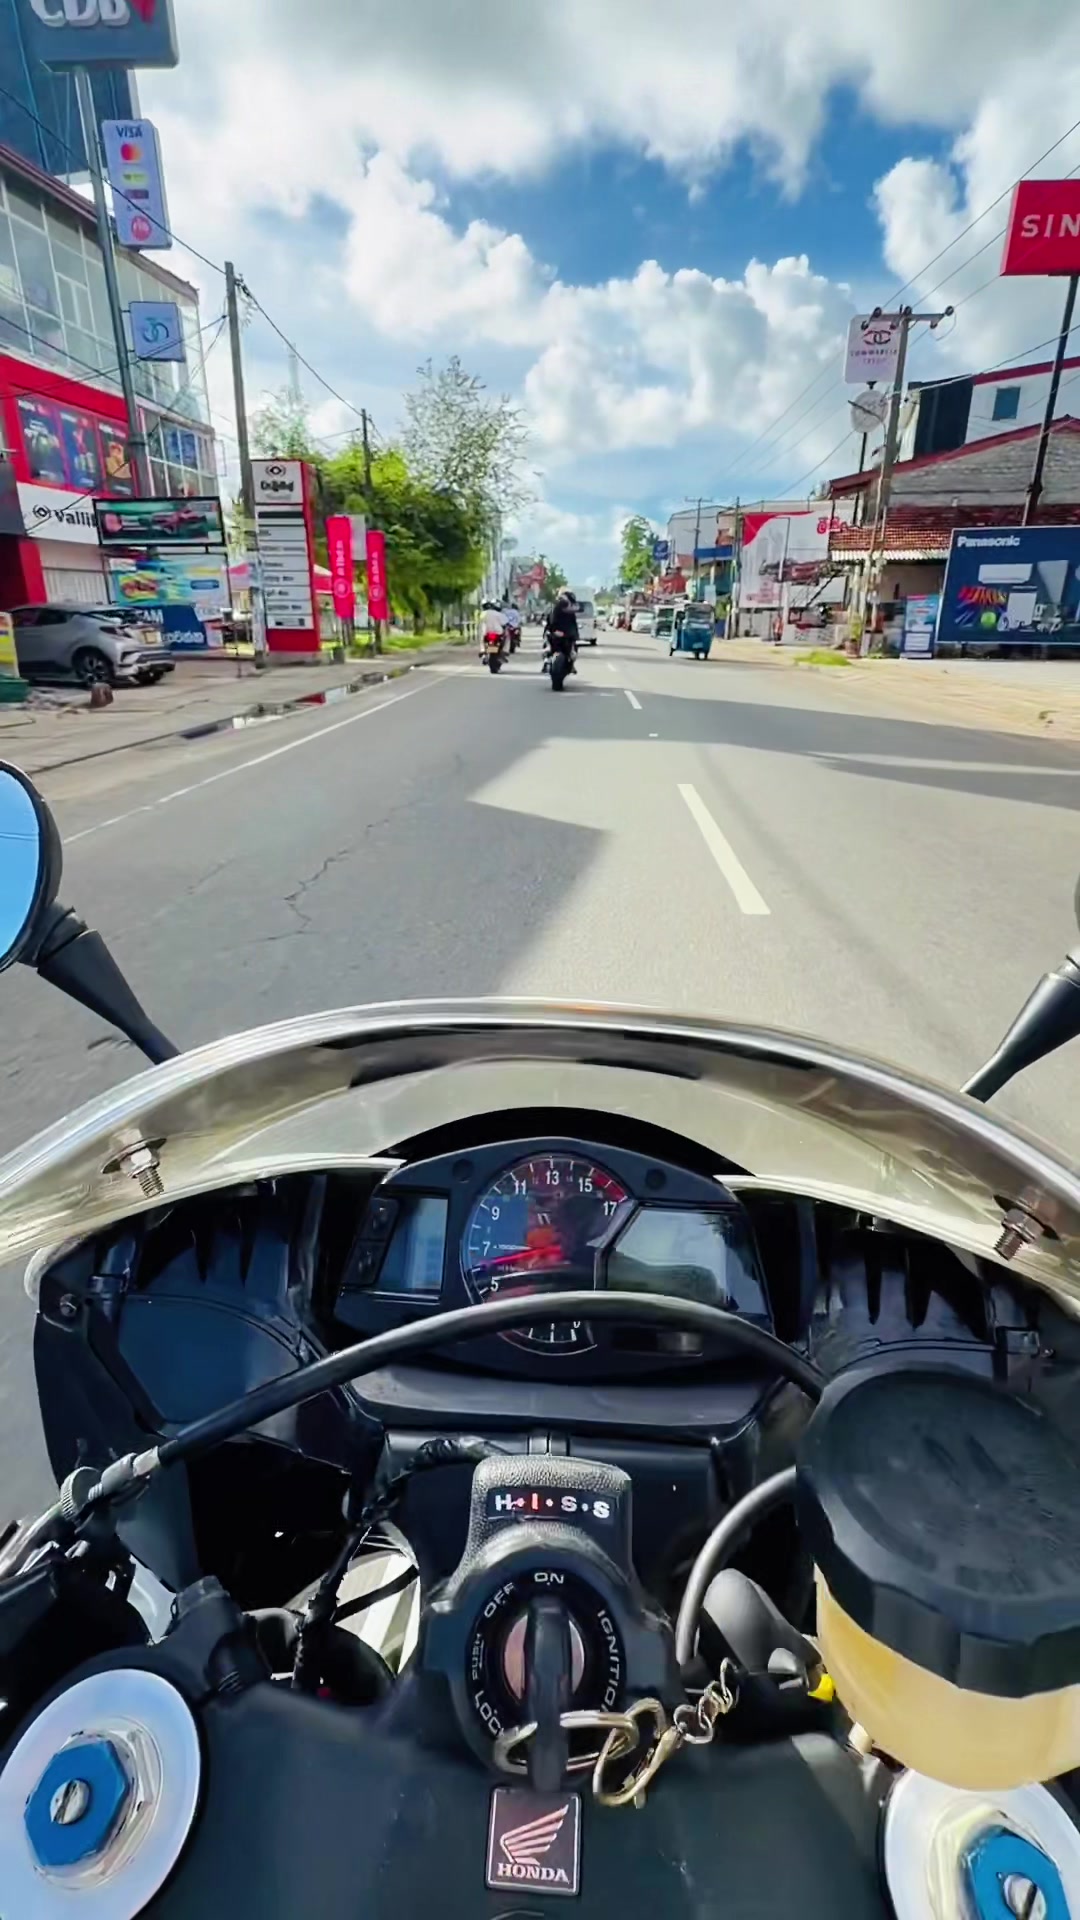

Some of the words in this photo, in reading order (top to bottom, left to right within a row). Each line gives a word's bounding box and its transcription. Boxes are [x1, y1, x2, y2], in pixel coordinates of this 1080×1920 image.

[116, 125, 143, 138] VISA
[957, 535, 1020, 547] Panasonic
[545, 1171, 559, 1185] 13
[578, 1177, 593, 1193] 15
[514, 1180, 527, 1195] 11
[491, 1206, 500, 1220] 9
[603, 1202, 617, 1216] 17
[483, 1241, 490, 1256] 7
[490, 1277, 499, 1291] 5
[534, 1572, 565, 1583] ON
[484, 1582, 517, 1618] OFF
[472, 1633, 482, 1681] PUSH
[497, 1862, 569, 1884] HONDA
